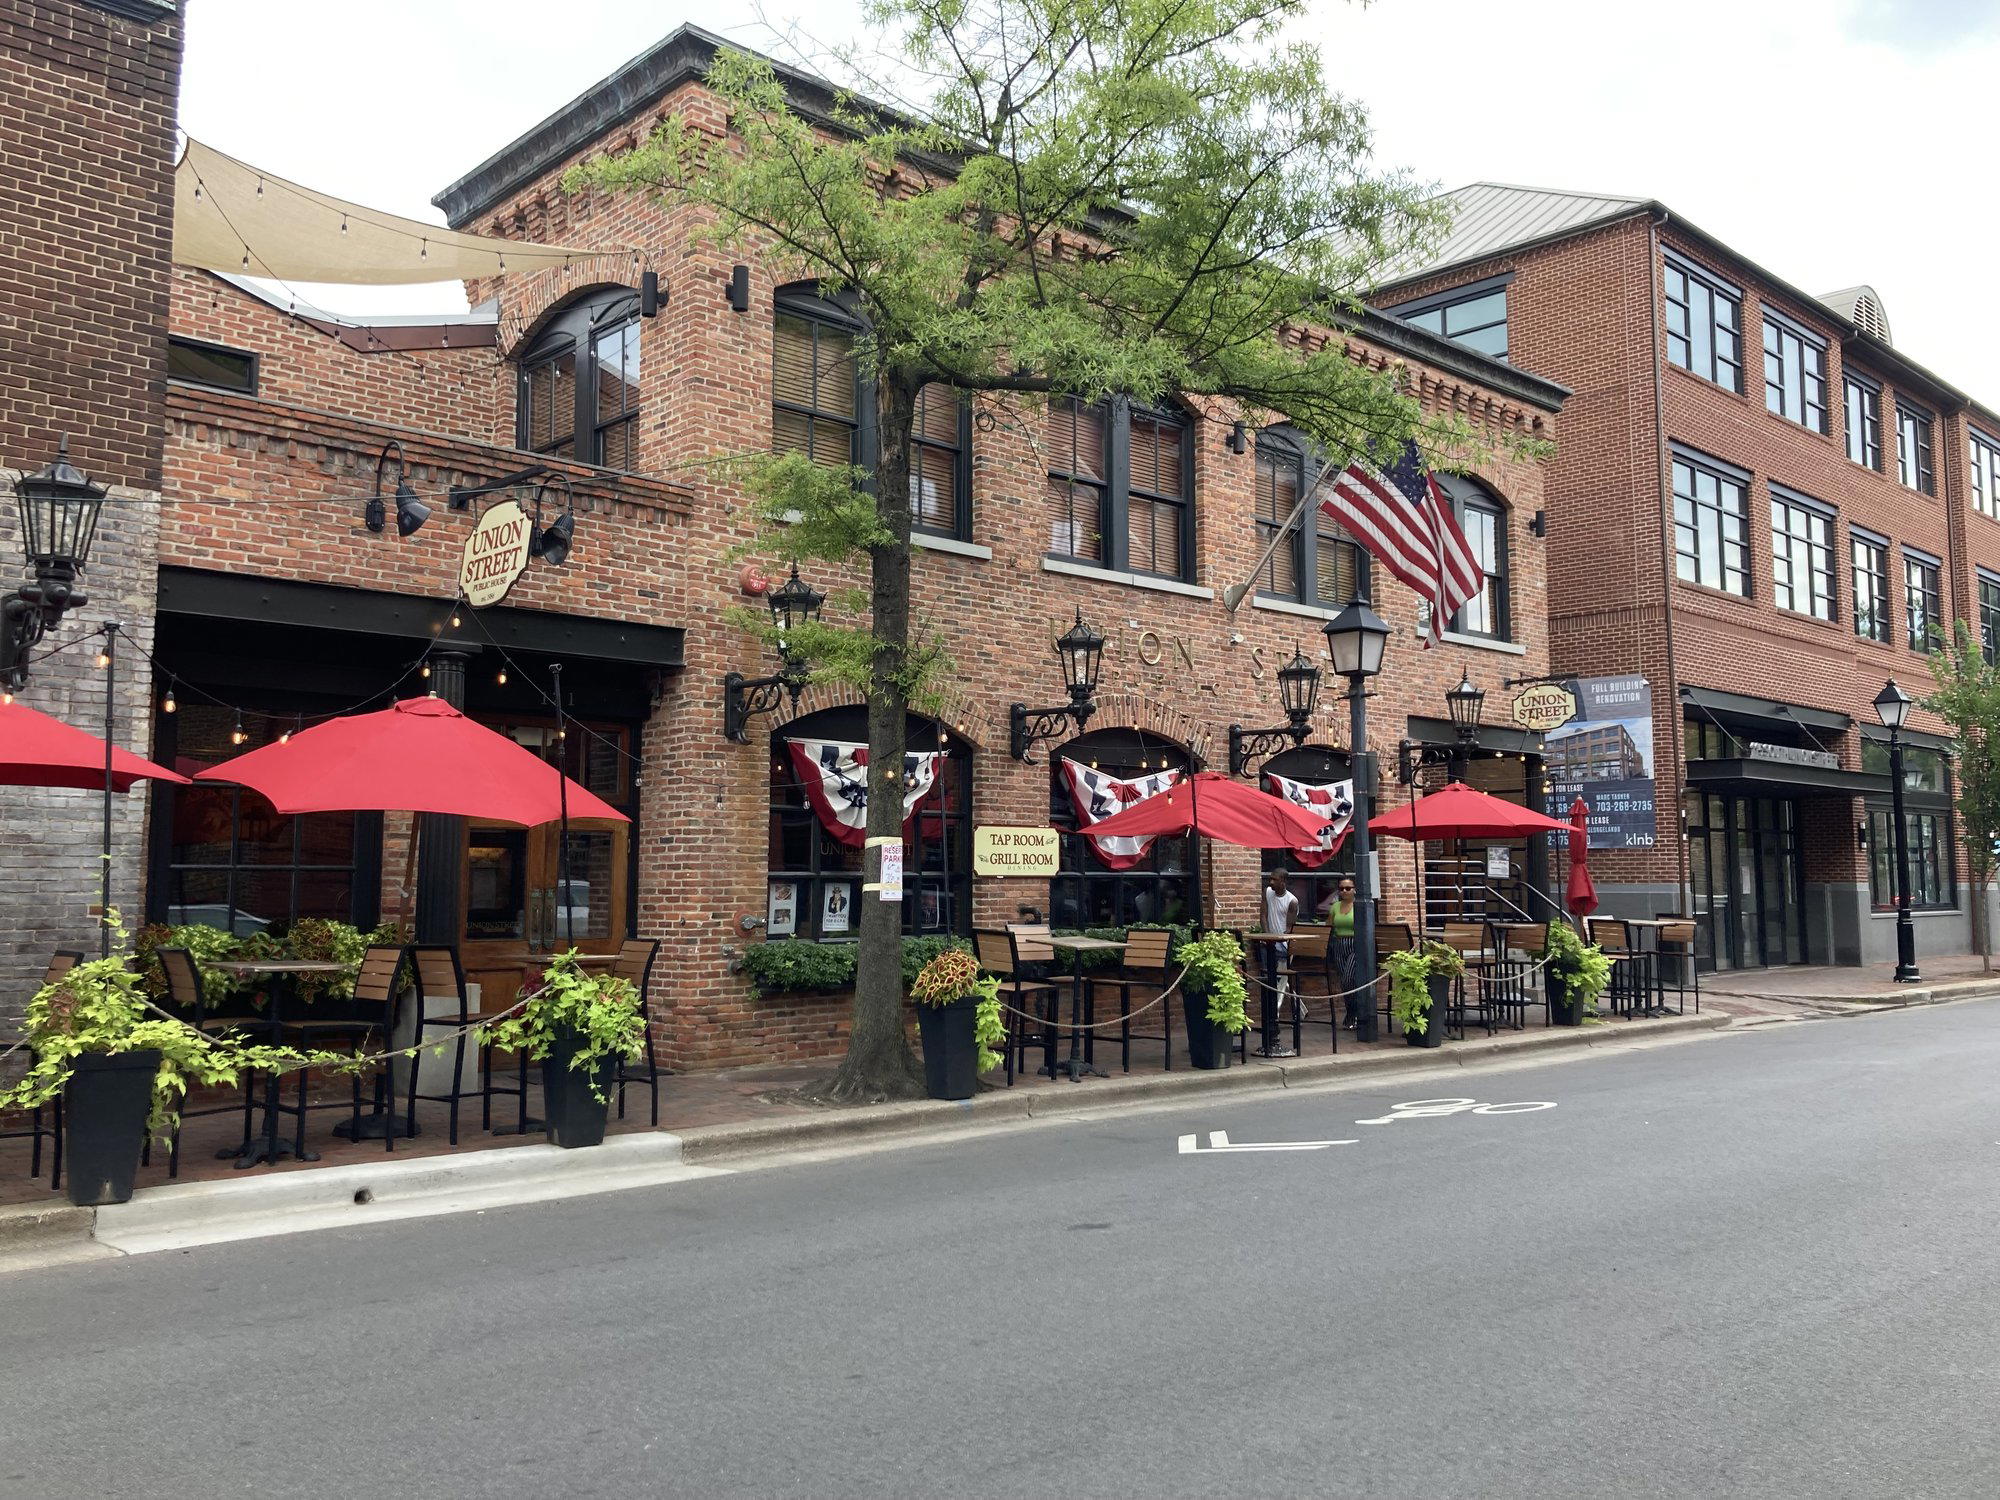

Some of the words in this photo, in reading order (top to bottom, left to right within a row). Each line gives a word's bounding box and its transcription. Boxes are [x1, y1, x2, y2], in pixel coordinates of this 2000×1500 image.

[472, 517, 525, 556] UNION
[465, 546, 523, 584] STREET
[473, 580, 490, 592] PUBLIC
[490, 575, 508, 588] HOUSE
[1591, 682, 1608, 693] FULL
[1609, 680, 1644, 691] BUILDING
[1520, 693, 1568, 708] UNION
[1595, 692, 1641, 704] RENOVATION
[1518, 704, 1571, 720] STREET
[1555, 784, 1567, 793] FOR
[1567, 783, 1584, 793] LEASE
[1596, 800, 1653, 812] 703-268-2735
[1591, 816, 1610, 825] LEASE
[990, 833, 1012, 846] TAP
[1013, 834, 1044, 847] ROOM
[1625, 832, 1654, 846] klnb
[989, 853, 1020, 865] GRILL
[1022, 853, 1054, 866] ROOM
